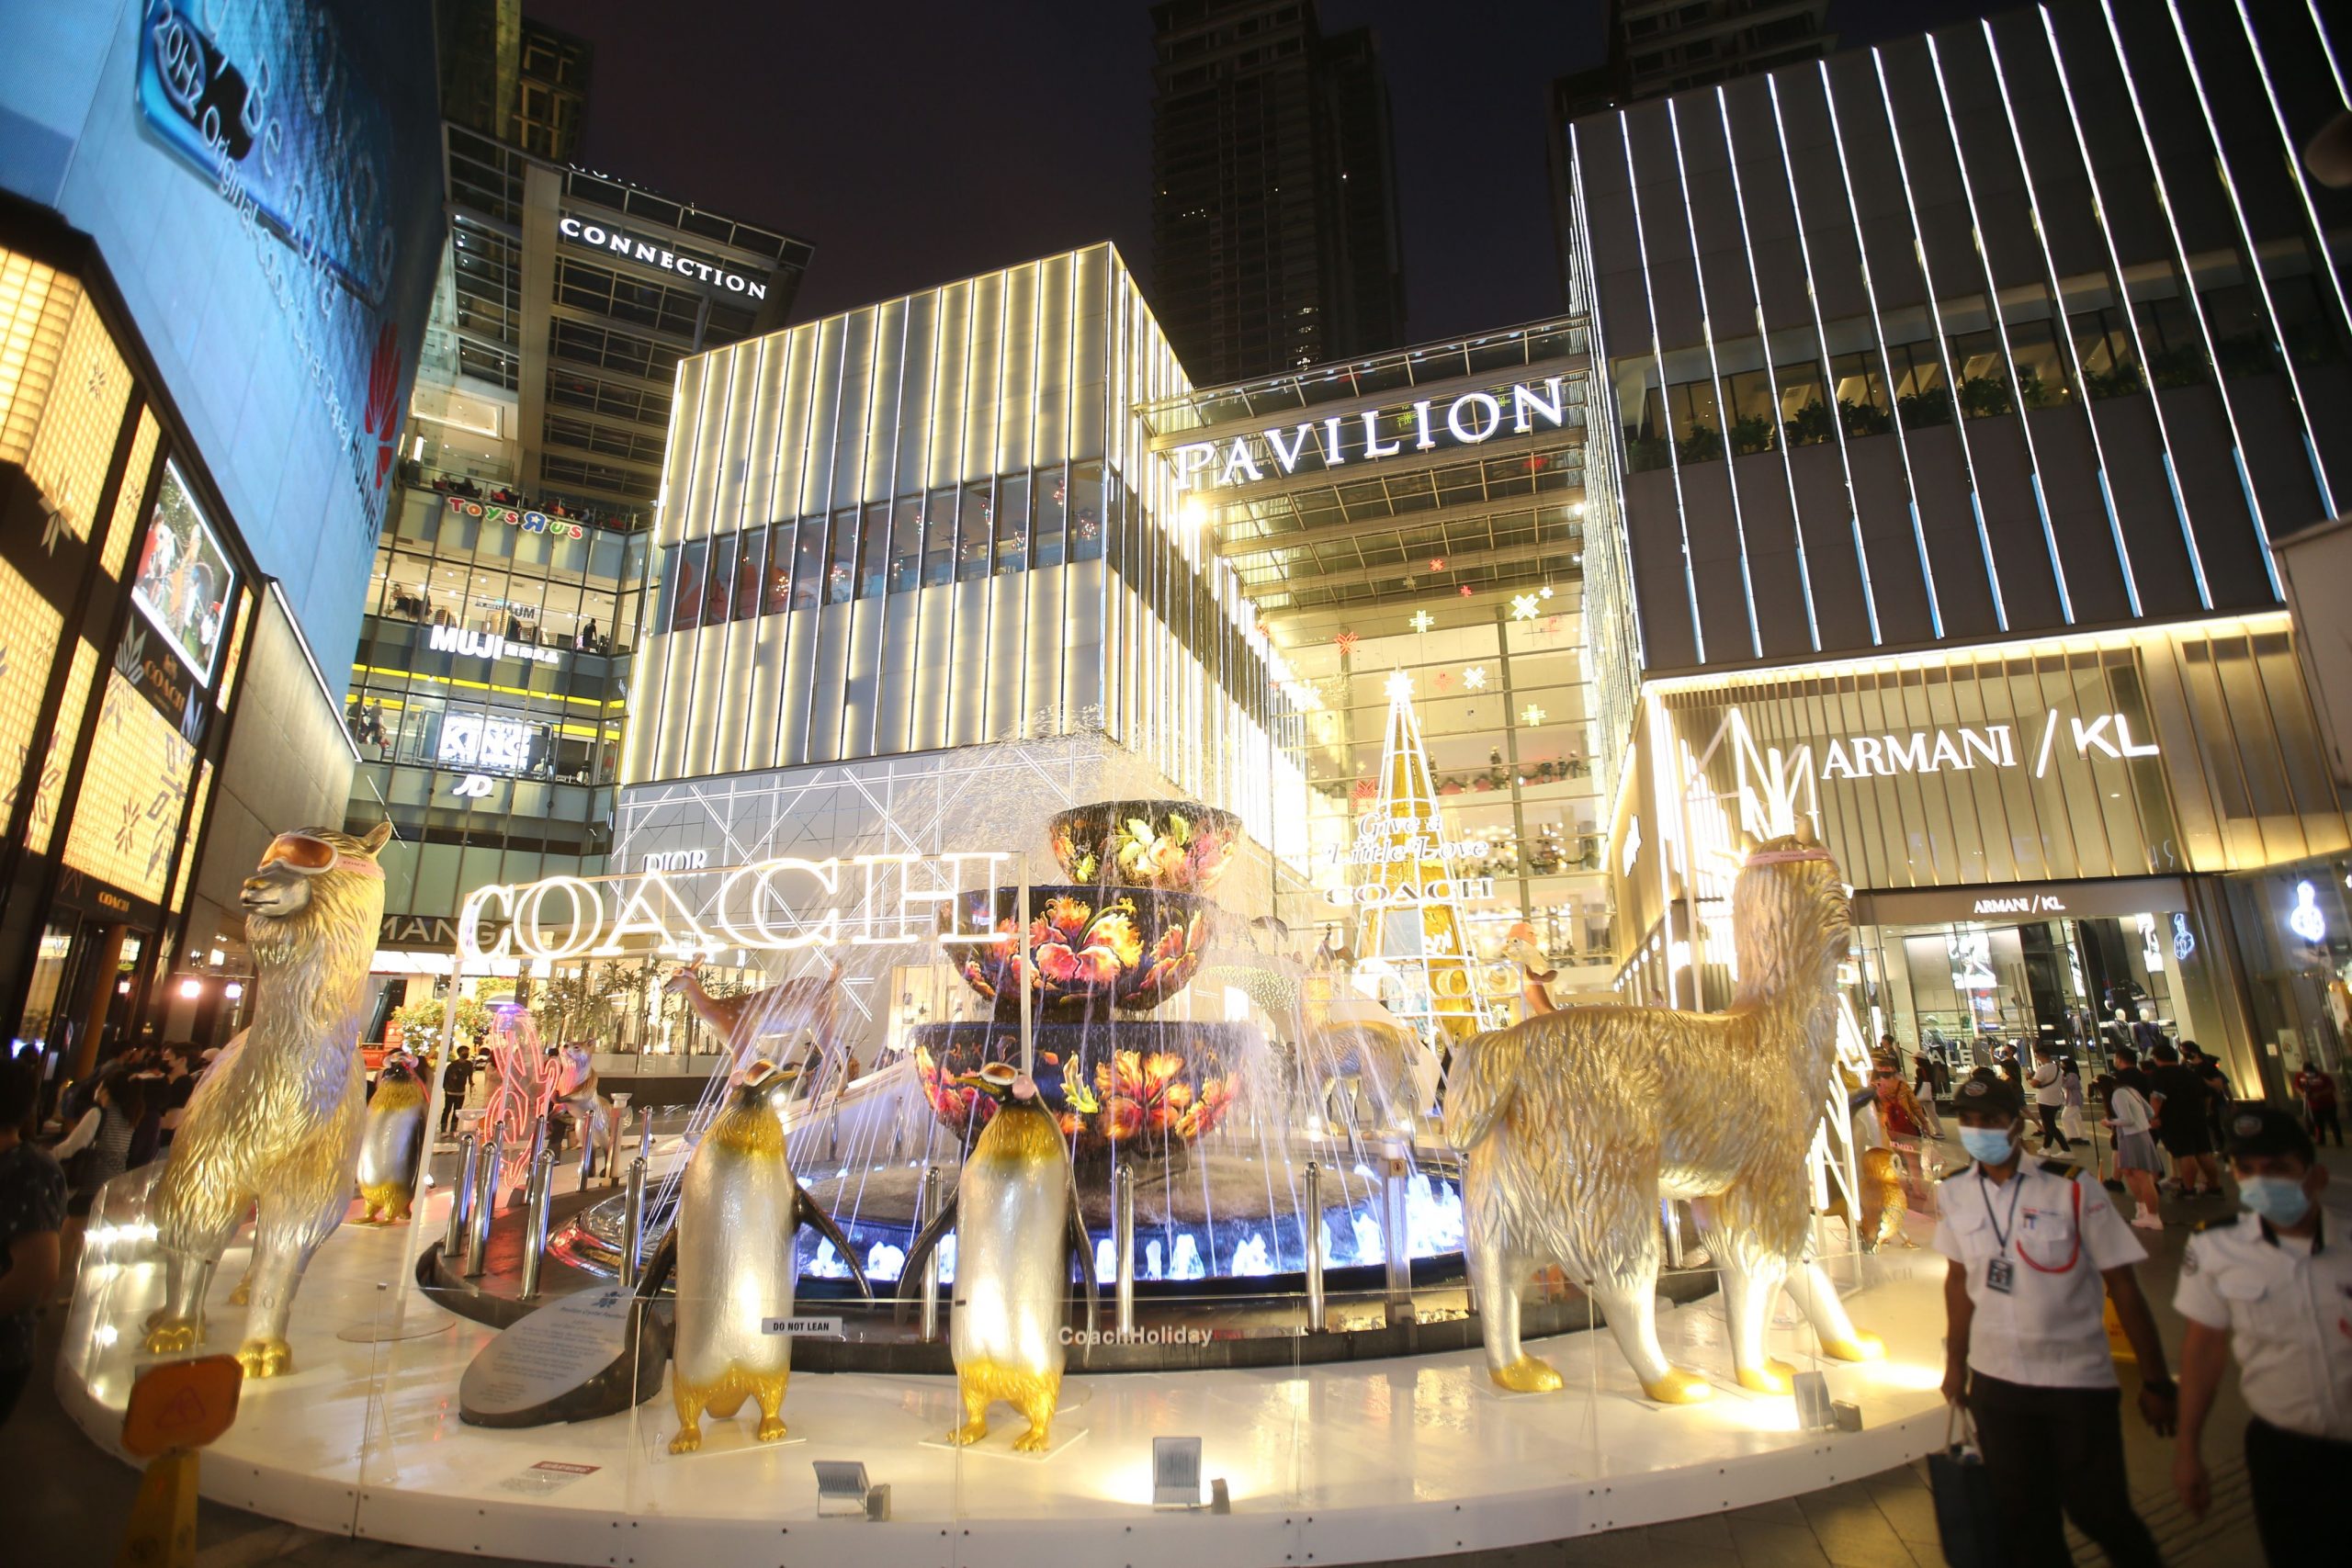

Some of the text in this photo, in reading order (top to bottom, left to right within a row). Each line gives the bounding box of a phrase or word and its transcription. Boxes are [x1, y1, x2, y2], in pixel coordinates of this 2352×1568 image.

[560, 218, 767, 300] CONNECTION
[1175, 377, 1564, 492] PAVILION
[429, 625, 504, 660] MUJI
[143, 659, 187, 714] COACH
[1821, 725, 2018, 781] ARMANI
[2069, 713, 2160, 761] KL
[453, 773, 493, 797] JD
[1358, 812, 1420, 841] Give
[642, 849, 707, 874] DIOR
[1323, 836, 1489, 864] Little Love
[457, 852, 1012, 961] COACH
[1323, 877, 1496, 907] COACH
[1973, 897, 2029, 914] ARMANI
[2041, 896, 2065, 911] KL
[379, 916, 514, 945] MANG
[773, 1323, 830, 1331] DO NOT LEAN
[1057, 1325, 1213, 1348] CoachHoliday
